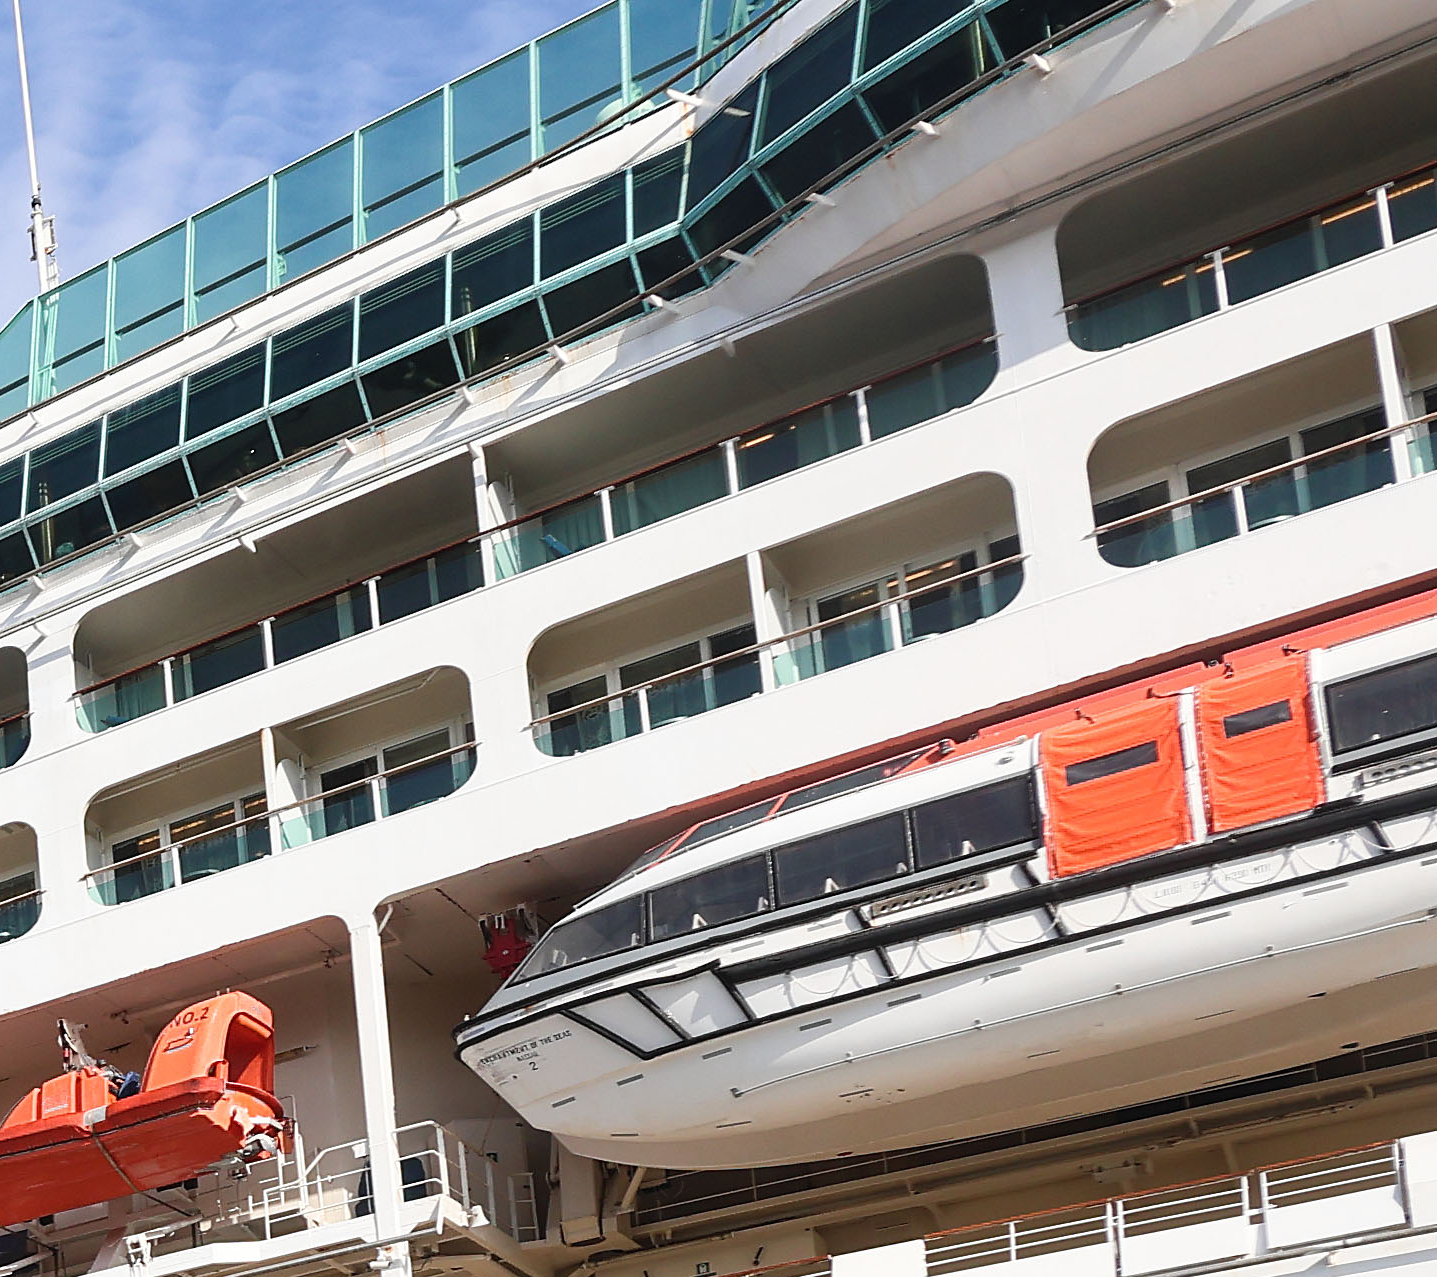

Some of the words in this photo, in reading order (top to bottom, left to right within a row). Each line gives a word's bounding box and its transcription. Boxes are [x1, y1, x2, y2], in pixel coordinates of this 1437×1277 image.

[539, 1036, 553, 1046] THE
[553, 1030, 572, 1041] SEAS
[529, 1061, 539, 1071] 2
